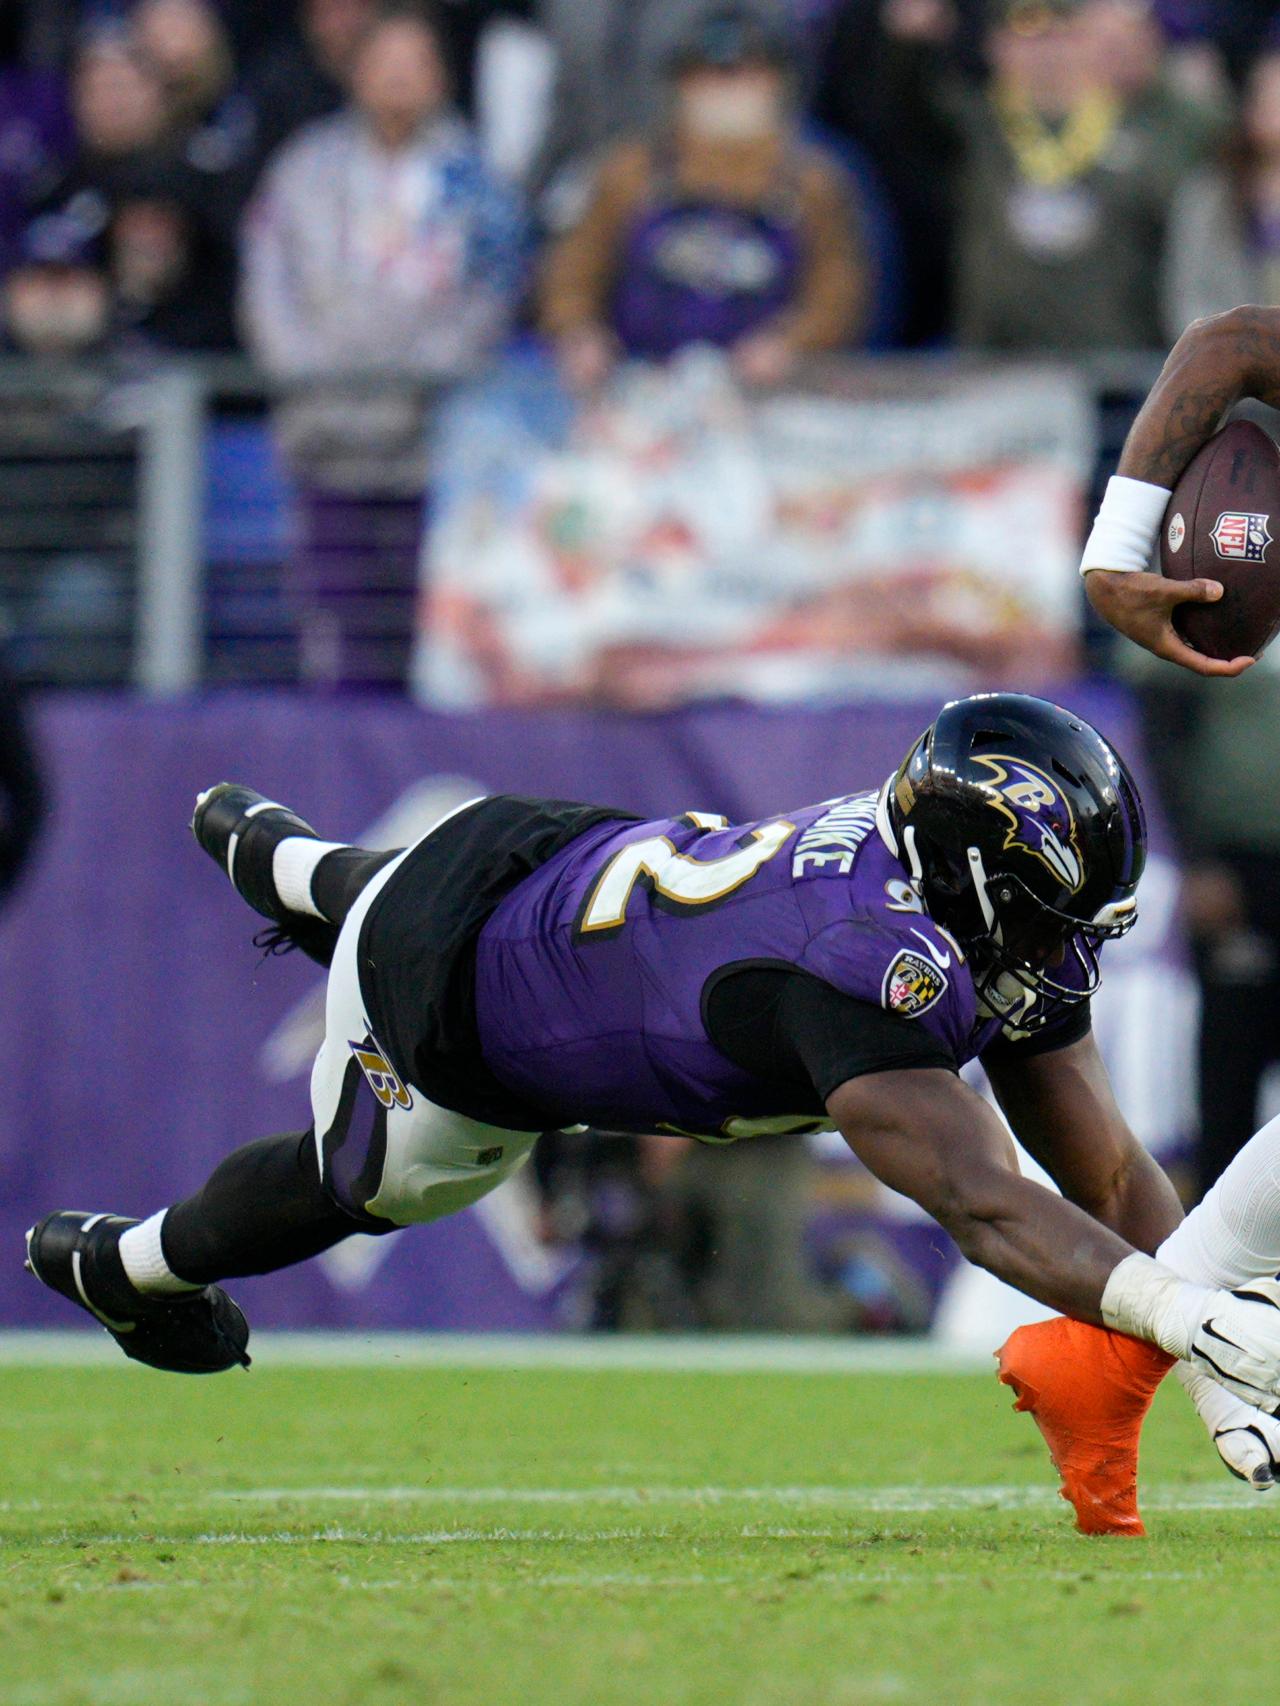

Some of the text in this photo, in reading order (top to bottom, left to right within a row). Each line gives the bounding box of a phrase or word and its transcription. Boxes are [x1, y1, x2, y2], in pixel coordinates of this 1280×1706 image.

[1217, 517, 1246, 554] NFL
[572, 811, 798, 944] 2
[903, 954, 942, 987] RAVENS
[347, 1016, 414, 1111] B
